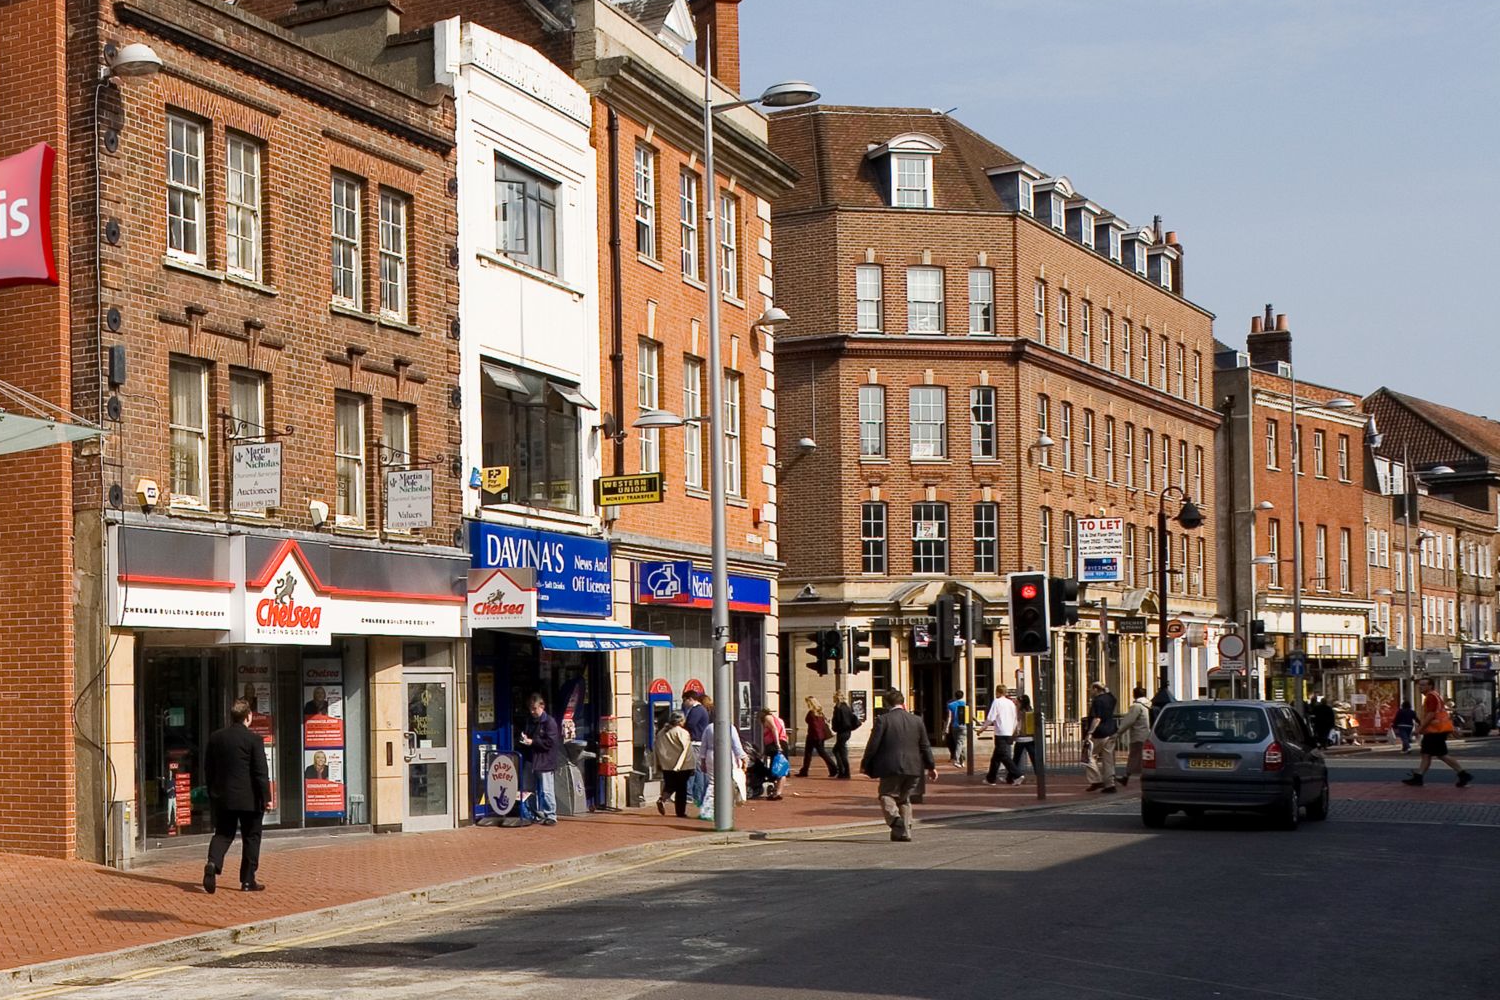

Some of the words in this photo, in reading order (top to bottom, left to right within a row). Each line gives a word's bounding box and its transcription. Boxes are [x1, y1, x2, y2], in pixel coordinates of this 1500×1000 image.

[246, 446, 270, 456] Martin
[245, 460, 280, 468] Nicholas
[603, 479, 647, 488] WESTERN
[1079, 520, 1095, 530] TO
[1100, 520, 1121, 529] LET
[486, 534, 565, 573] DAVINA'S
[574, 555, 592, 571] News
[594, 557, 608, 573] And
[572, 576, 585, 592] Off
[586, 578, 610, 594] Licence
[256, 598, 321, 628] Chelsea
[473, 602, 525, 616] Chelsea
[888, 617, 937, 625] PITCHE
[493, 762, 512, 772] play
[492, 772, 513, 782] here!
